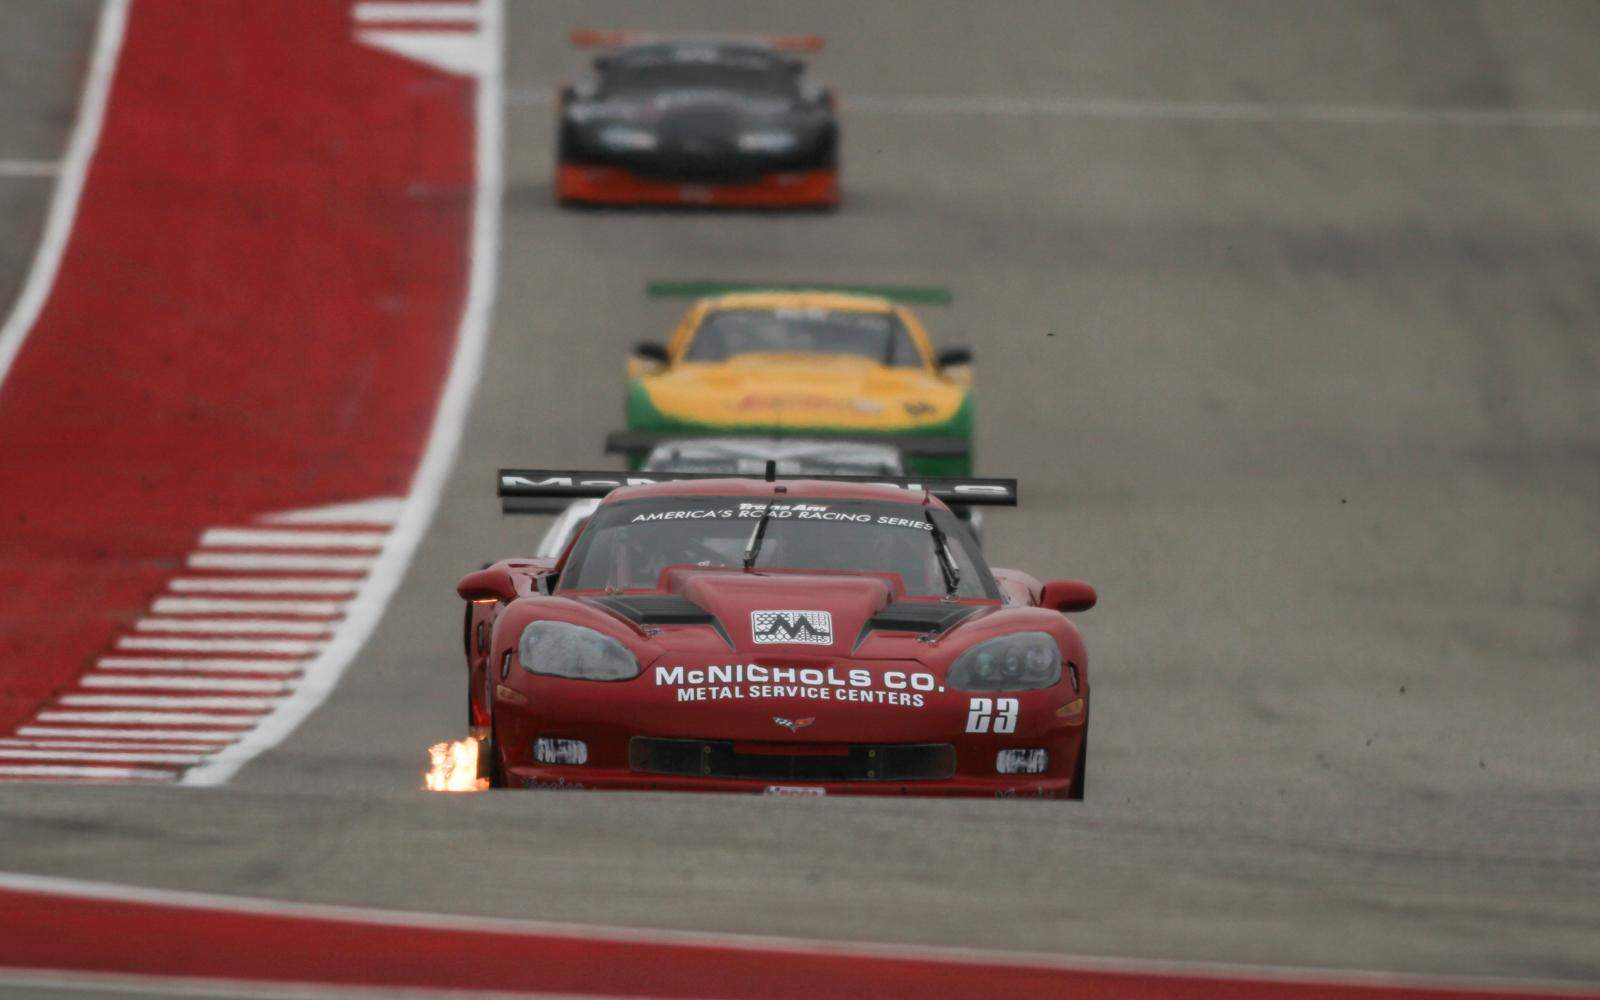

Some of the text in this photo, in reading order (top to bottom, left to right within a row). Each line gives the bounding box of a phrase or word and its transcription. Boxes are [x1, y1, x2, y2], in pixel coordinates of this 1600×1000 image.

[631, 509, 934, 531] AMERICA'S ROAD RACING SERIES
[655, 663, 945, 693] McNICHOLS CO.
[677, 686, 925, 707] METAL SERVICE CENTERS
[965, 697, 1020, 733] 23
